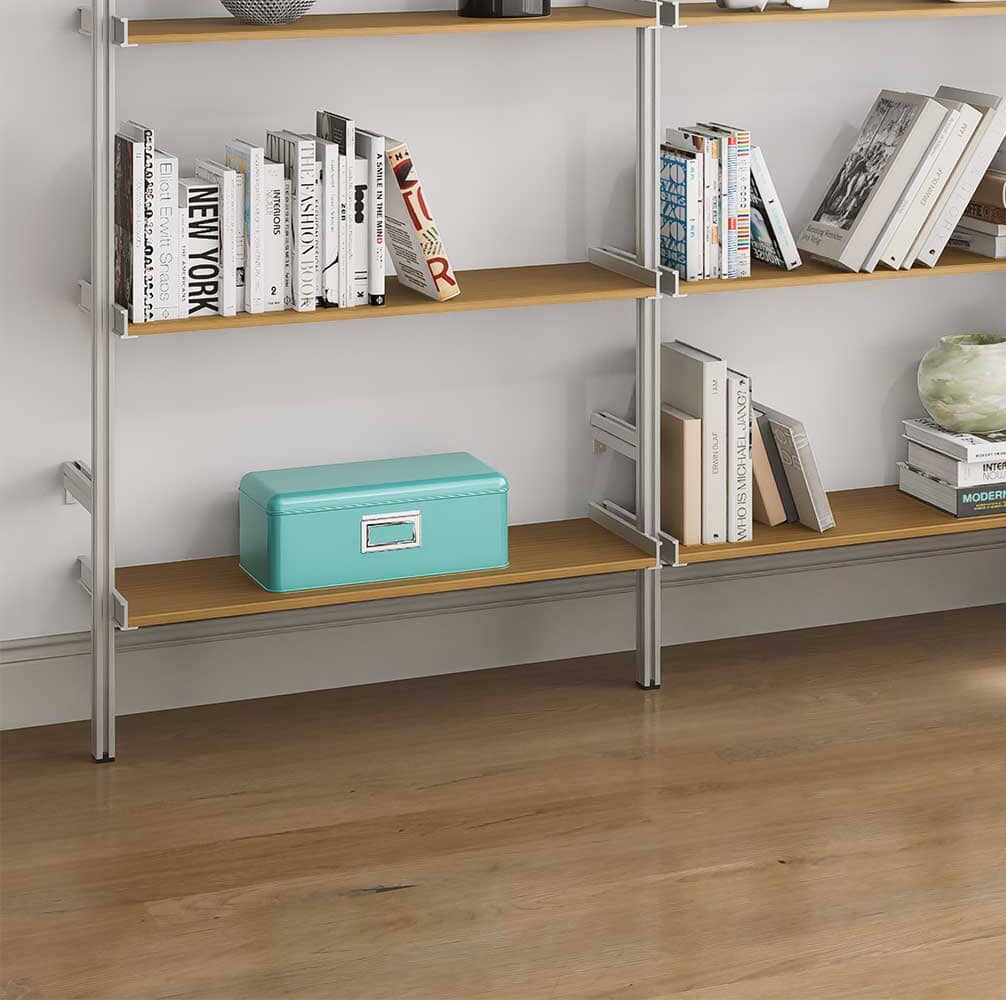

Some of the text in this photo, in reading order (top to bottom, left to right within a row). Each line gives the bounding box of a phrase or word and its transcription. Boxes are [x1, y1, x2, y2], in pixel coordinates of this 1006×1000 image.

[157, 162, 173, 302] Elliott Erwitt Snaps
[188, 187, 219, 315] NEW YORK
[273, 189, 281, 236] INTERIORS
[301, 143, 315, 309] THE FASHION BOOK
[376, 190, 383, 200] IN
[271, 286, 277, 296] 2
[737, 389, 747, 542] WHO IS MICHAEL JANG?
